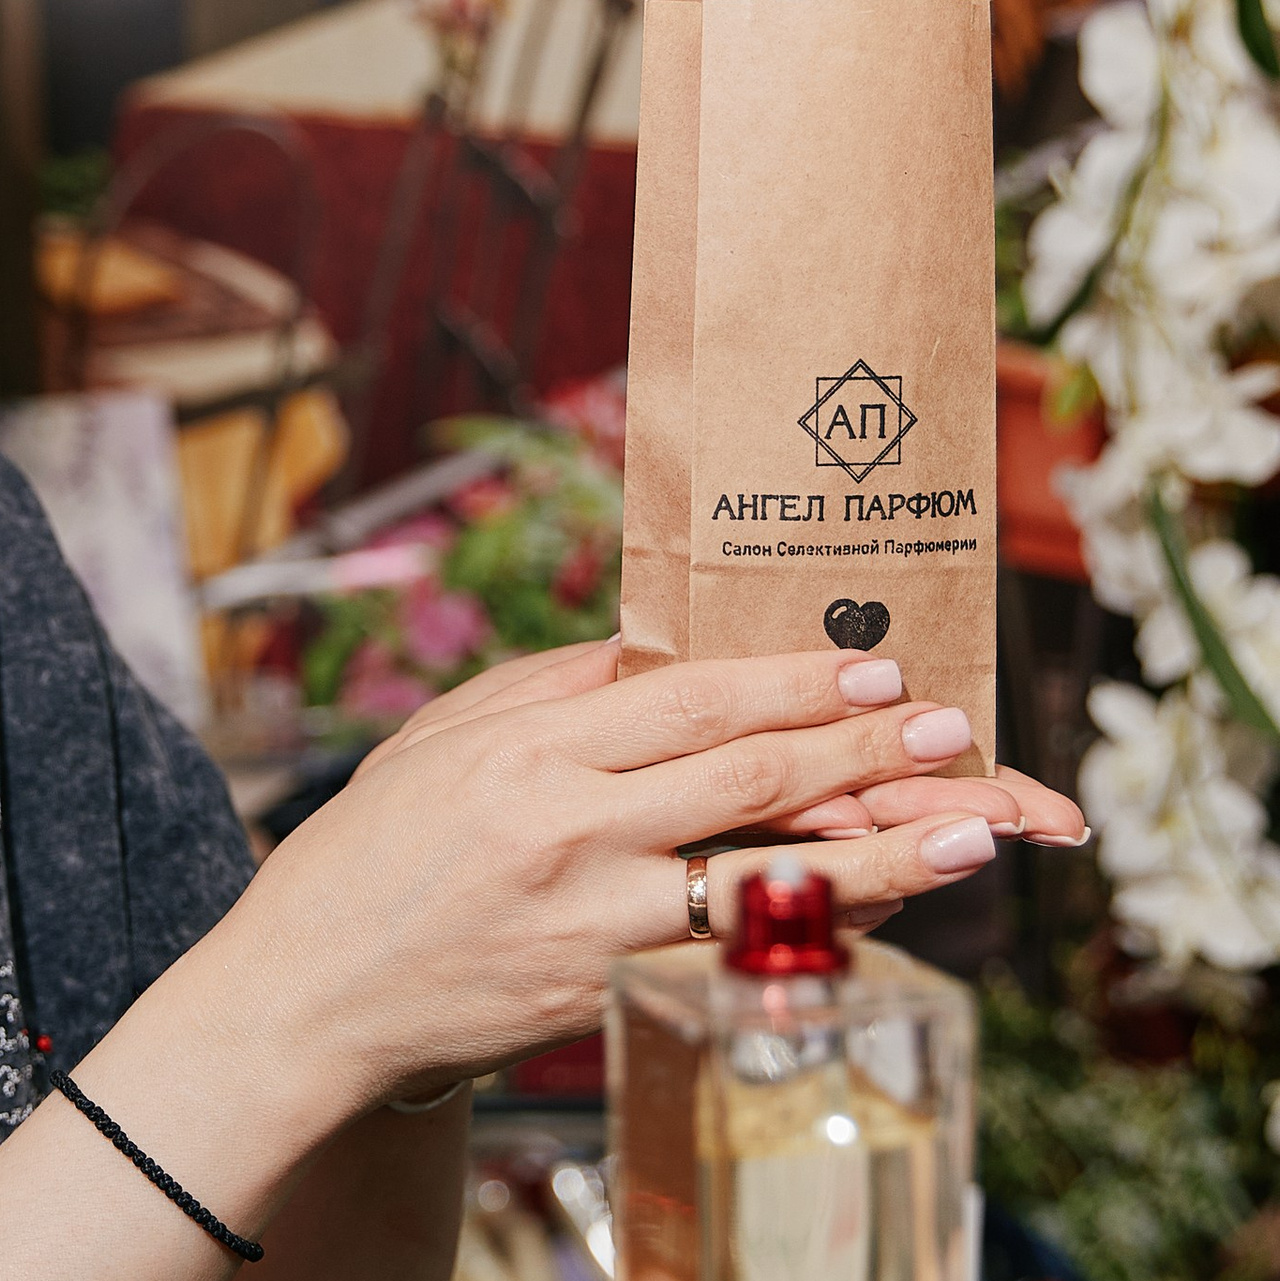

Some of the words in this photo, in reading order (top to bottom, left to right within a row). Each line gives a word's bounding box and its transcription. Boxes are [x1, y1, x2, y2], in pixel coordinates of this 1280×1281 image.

[823, 403, 887, 440] АП
[711, 493, 825, 522] АНГЕЛ
[843, 488, 978, 522] ПАРФЮМ
[722, 540, 772, 557] Салон
[776, 538, 880, 557] Селективной
[884, 537, 978, 558] Парфюмерии
